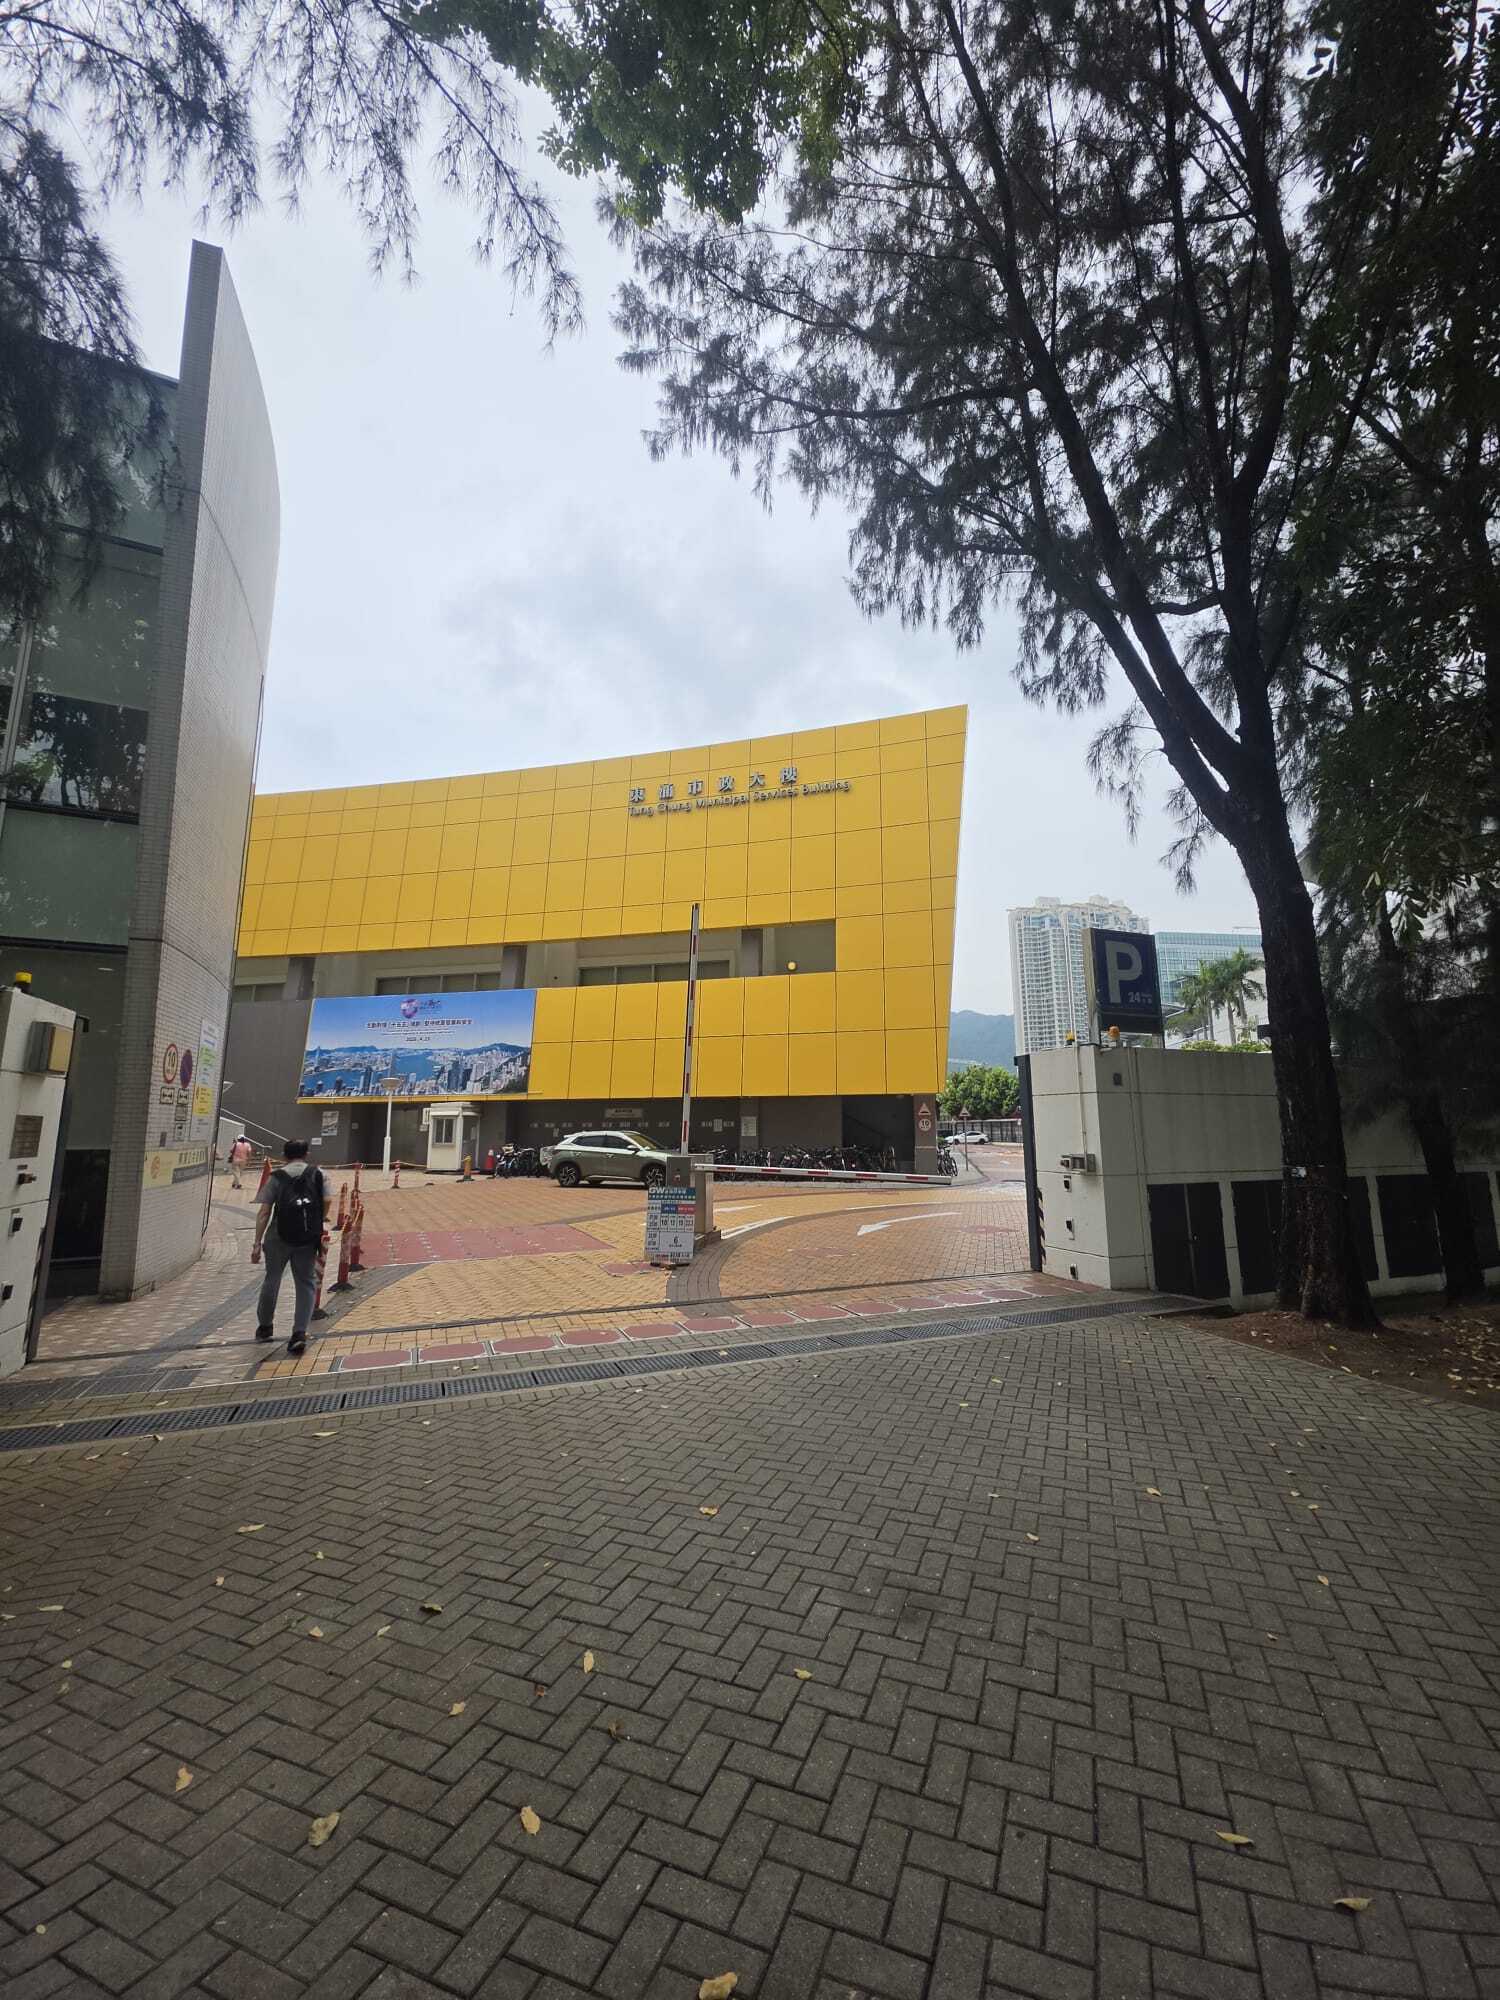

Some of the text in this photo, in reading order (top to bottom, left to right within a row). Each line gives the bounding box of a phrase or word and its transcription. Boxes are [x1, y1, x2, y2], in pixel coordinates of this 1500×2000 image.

[657, 800, 692, 813] Chung
[696, 793, 750, 810] Municipal
[753, 786, 799, 801] Services
[802, 778, 851, 795] Building
[1105, 940, 1143, 1004] P
[1128, 991, 1140, 1003] 24
